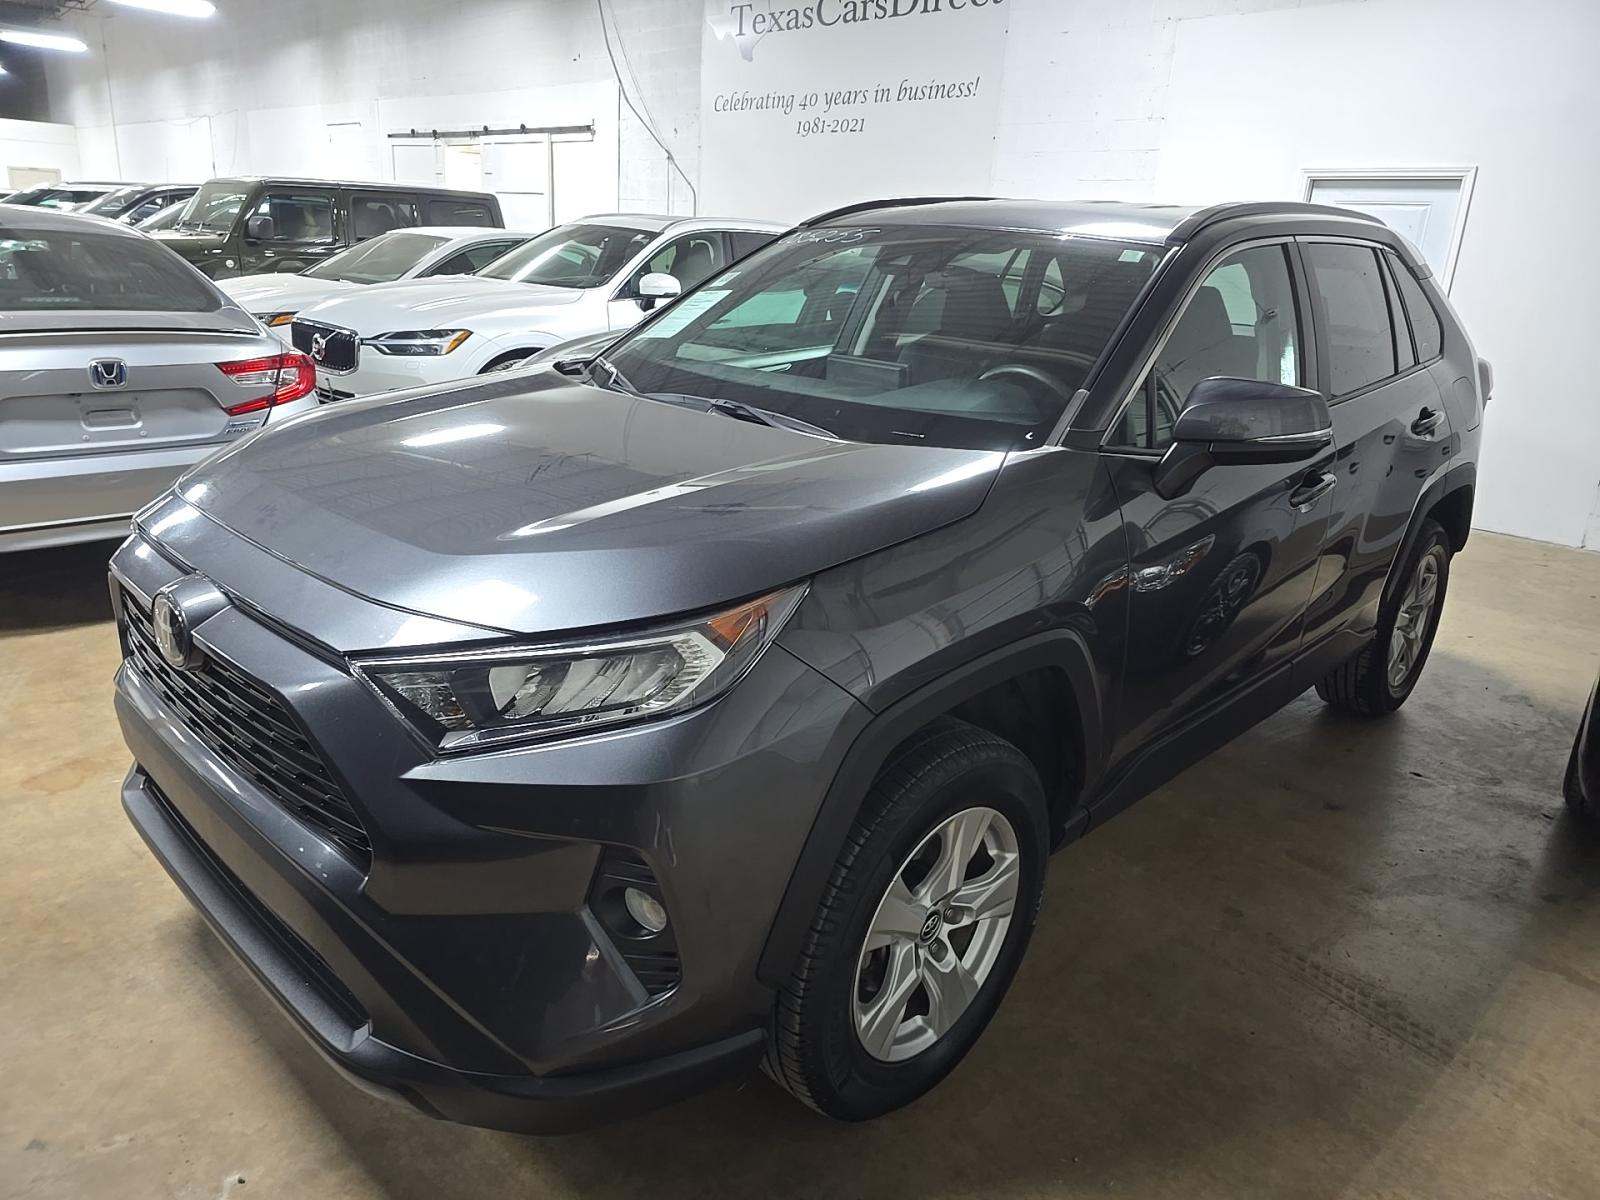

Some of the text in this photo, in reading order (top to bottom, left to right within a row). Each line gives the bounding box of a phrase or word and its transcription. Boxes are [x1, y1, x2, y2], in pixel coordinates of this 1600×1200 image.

[731, 0, 1003, 37] TexasCarsD
[714, 76, 980, 116] Celebrating 40 years in business!
[796, 116, 865, 137] 1981-2021
